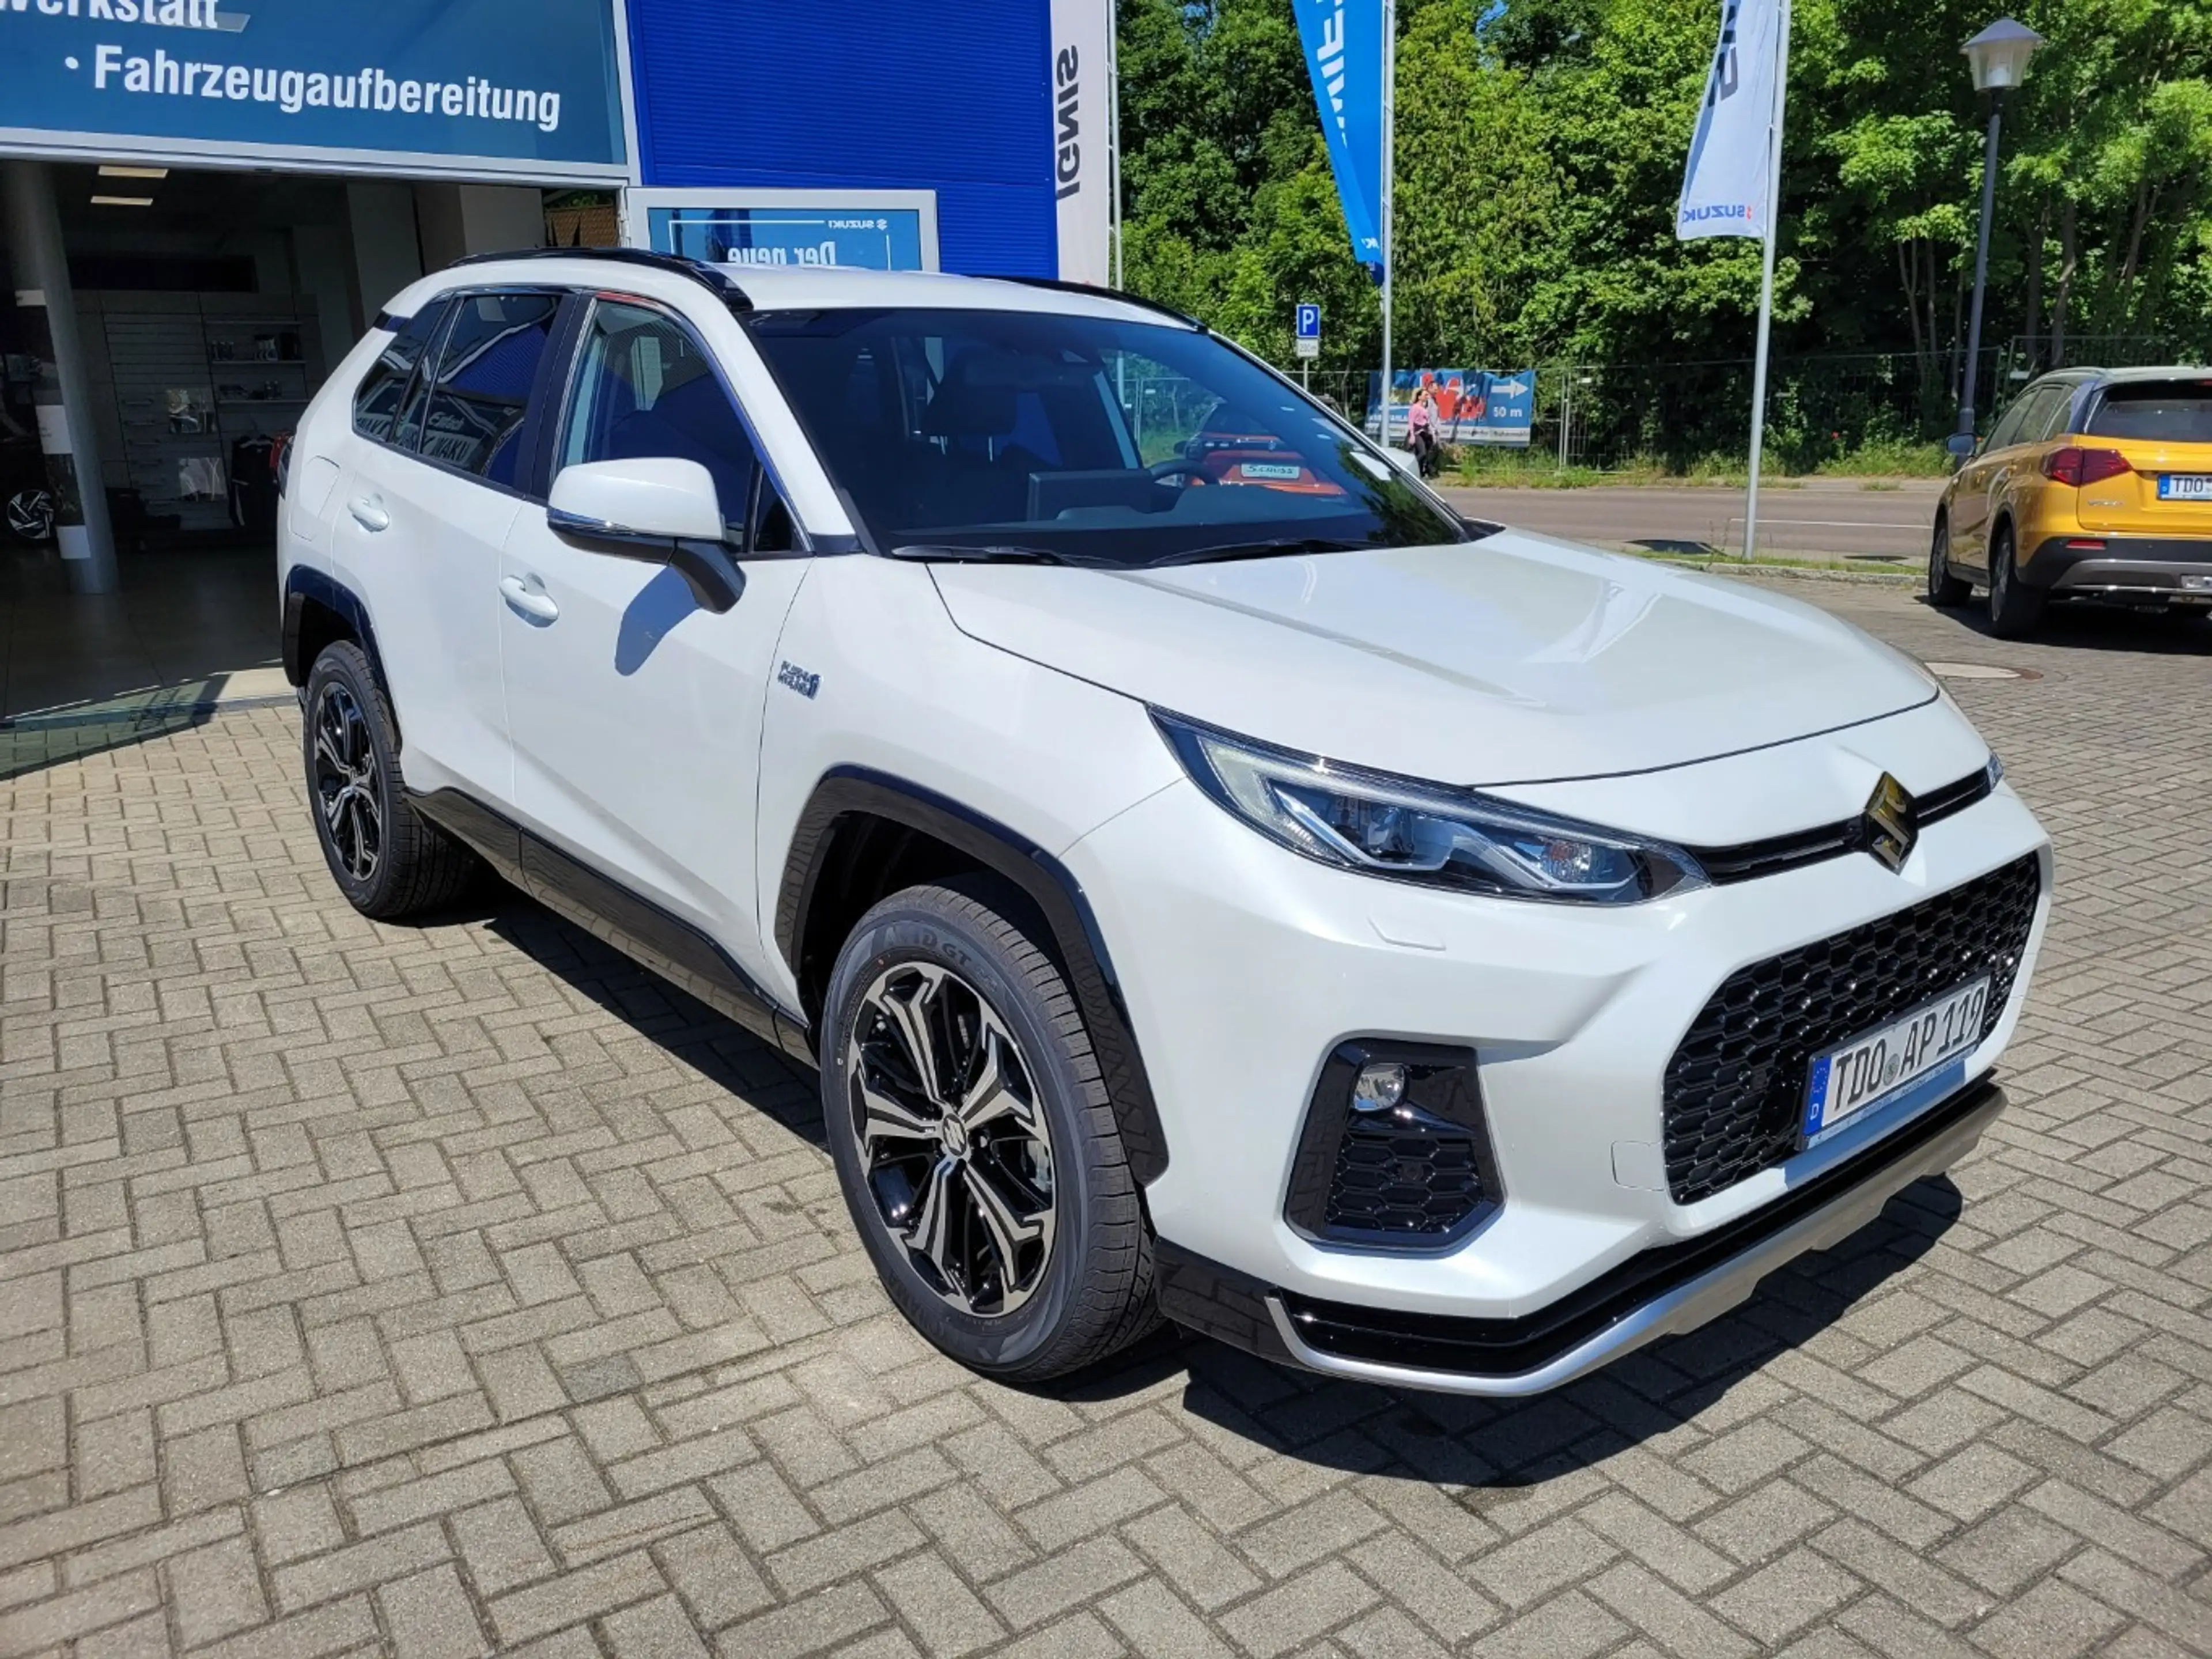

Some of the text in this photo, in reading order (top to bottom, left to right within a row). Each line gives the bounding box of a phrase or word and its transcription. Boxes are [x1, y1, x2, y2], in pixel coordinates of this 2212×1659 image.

[94, 44, 560, 132] Fahrzeugaufbereitung
[1303, 309, 1315, 333] P
[1493, 406, 1523, 418] 50 m
[2173, 478, 2203, 494] TDO
[942, 942, 972, 965] GT
[1835, 1039, 1886, 1111] TDO
[1900, 1012, 1937, 1077] AP
[1937, 986, 1984, 1053] 119
